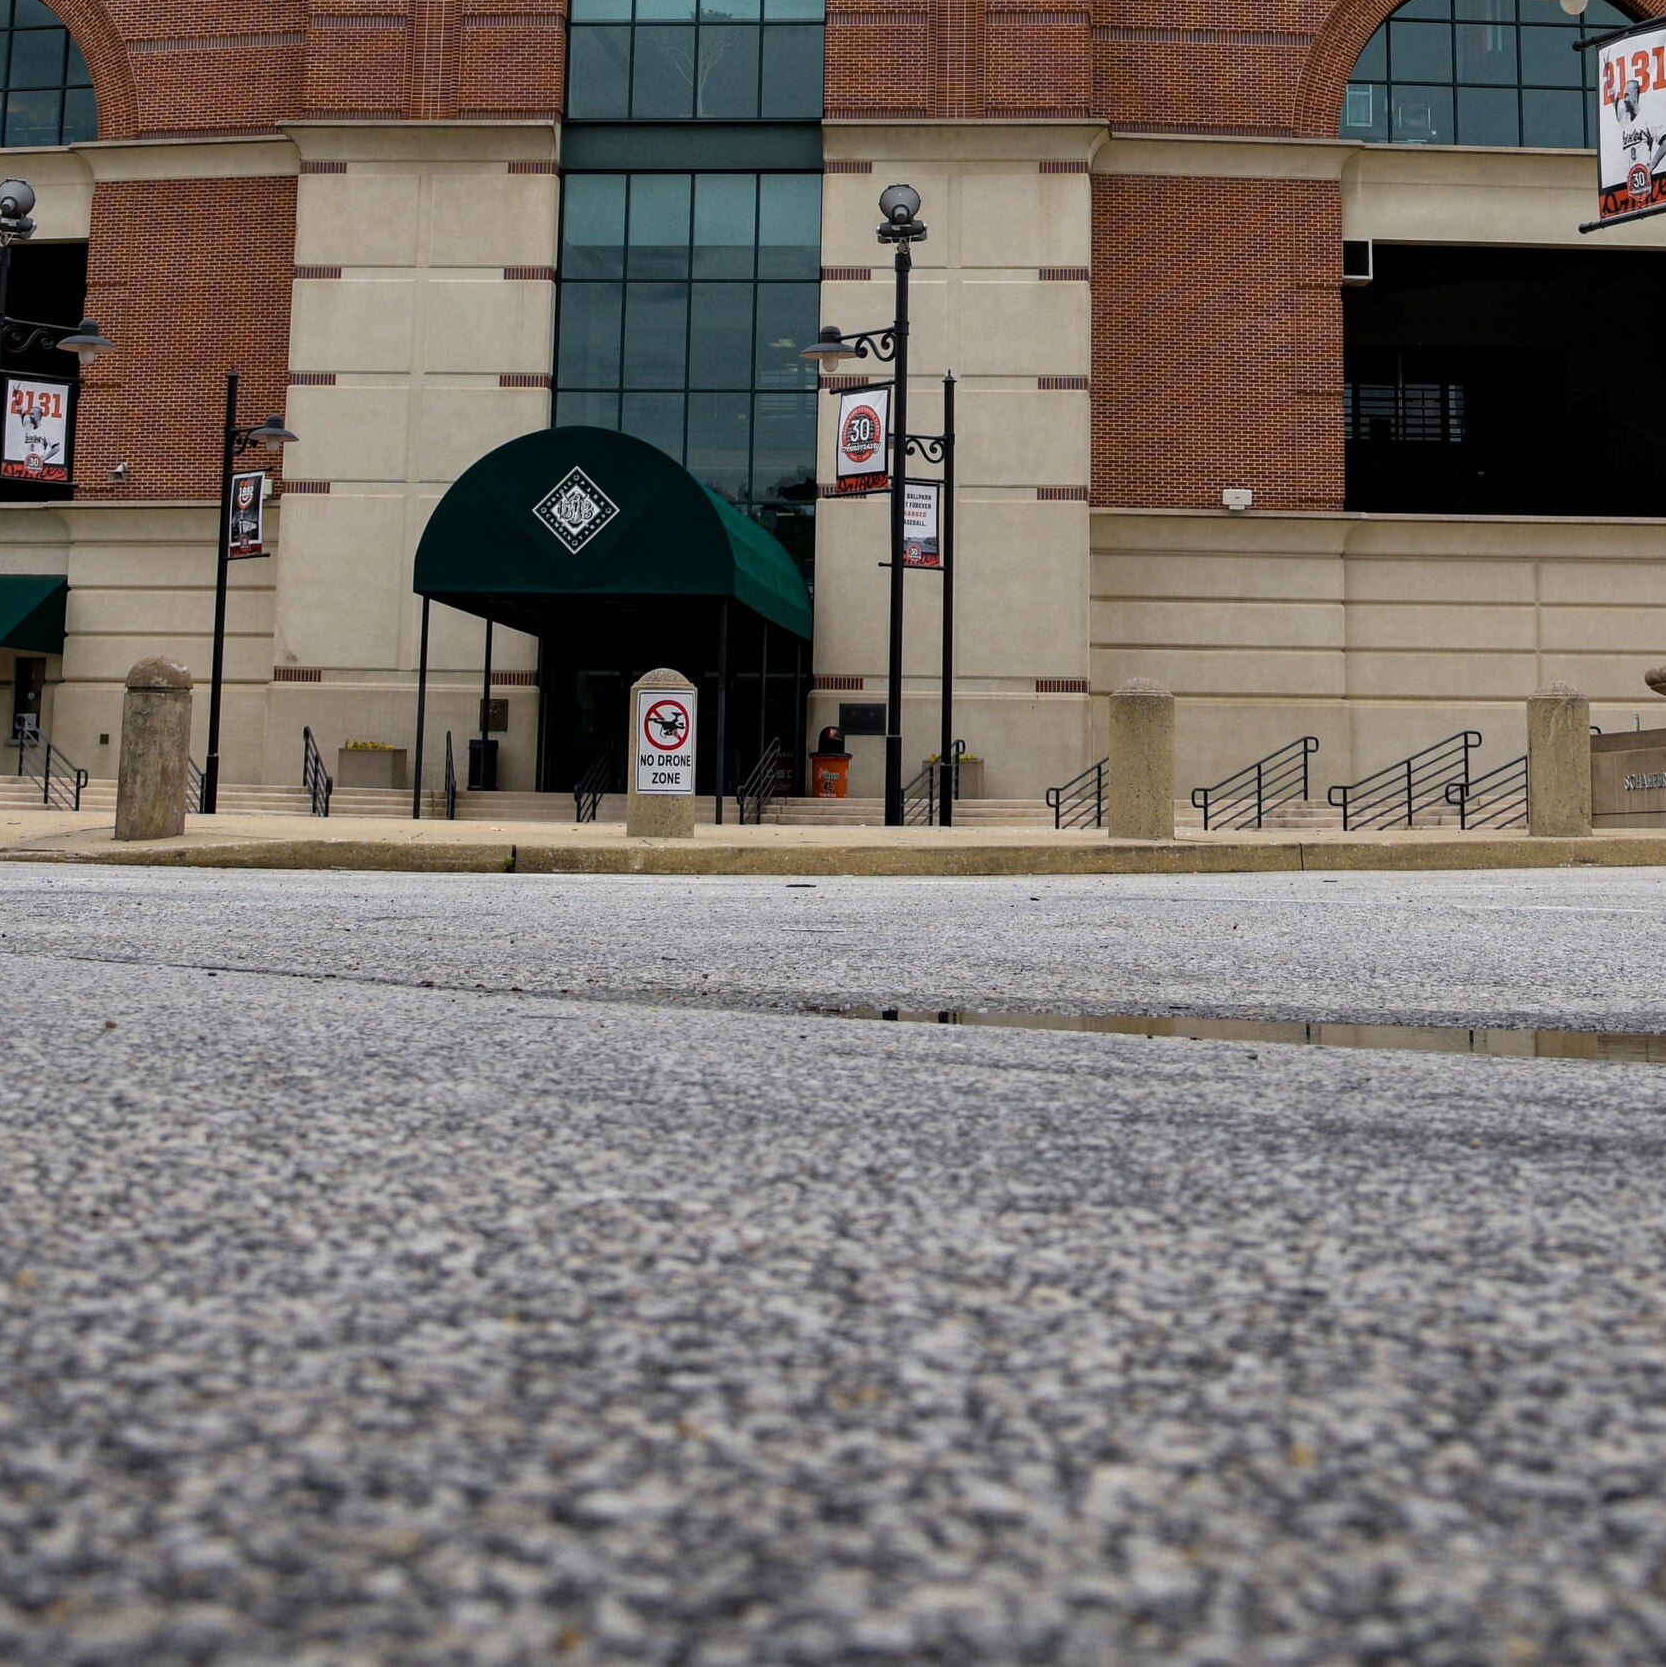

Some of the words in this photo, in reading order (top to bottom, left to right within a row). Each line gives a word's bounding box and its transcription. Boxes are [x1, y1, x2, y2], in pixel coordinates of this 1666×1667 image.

[1632, 171, 1645, 188] 30
[11, 389, 62, 419] 2131
[850, 418, 870, 442] 30
[28, 458, 39, 467] 30
[640, 754, 654, 766] NO
[658, 755, 691, 767] DRONE
[652, 772, 680, 784] ZONE
